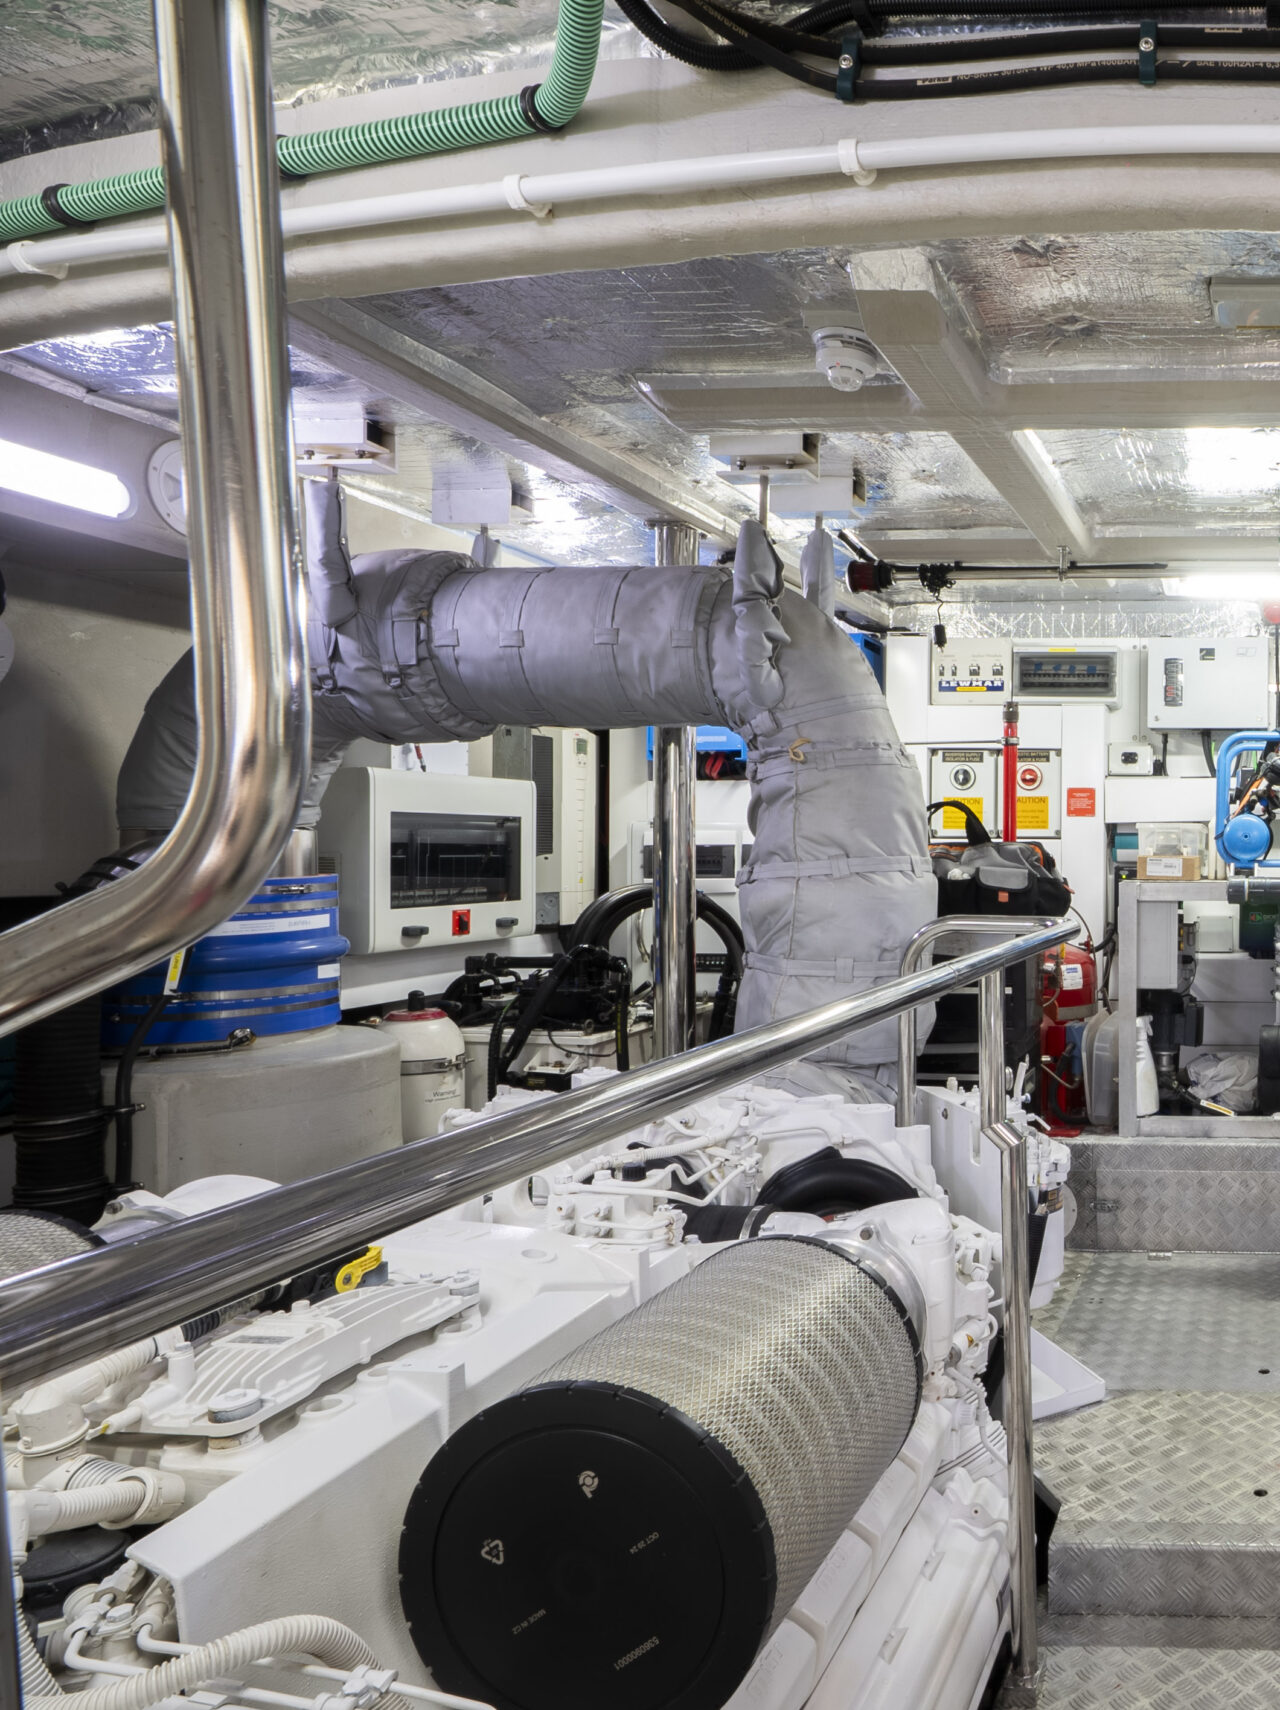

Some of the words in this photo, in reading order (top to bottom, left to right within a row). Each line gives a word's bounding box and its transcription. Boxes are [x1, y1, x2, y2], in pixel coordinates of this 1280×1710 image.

[646, 1532, 659, 1544] OCT
[528, 1609, 546, 1623] MADE
[512, 1626, 521, 1634] CZ
[614, 1636, 659, 1670] 5360900001
